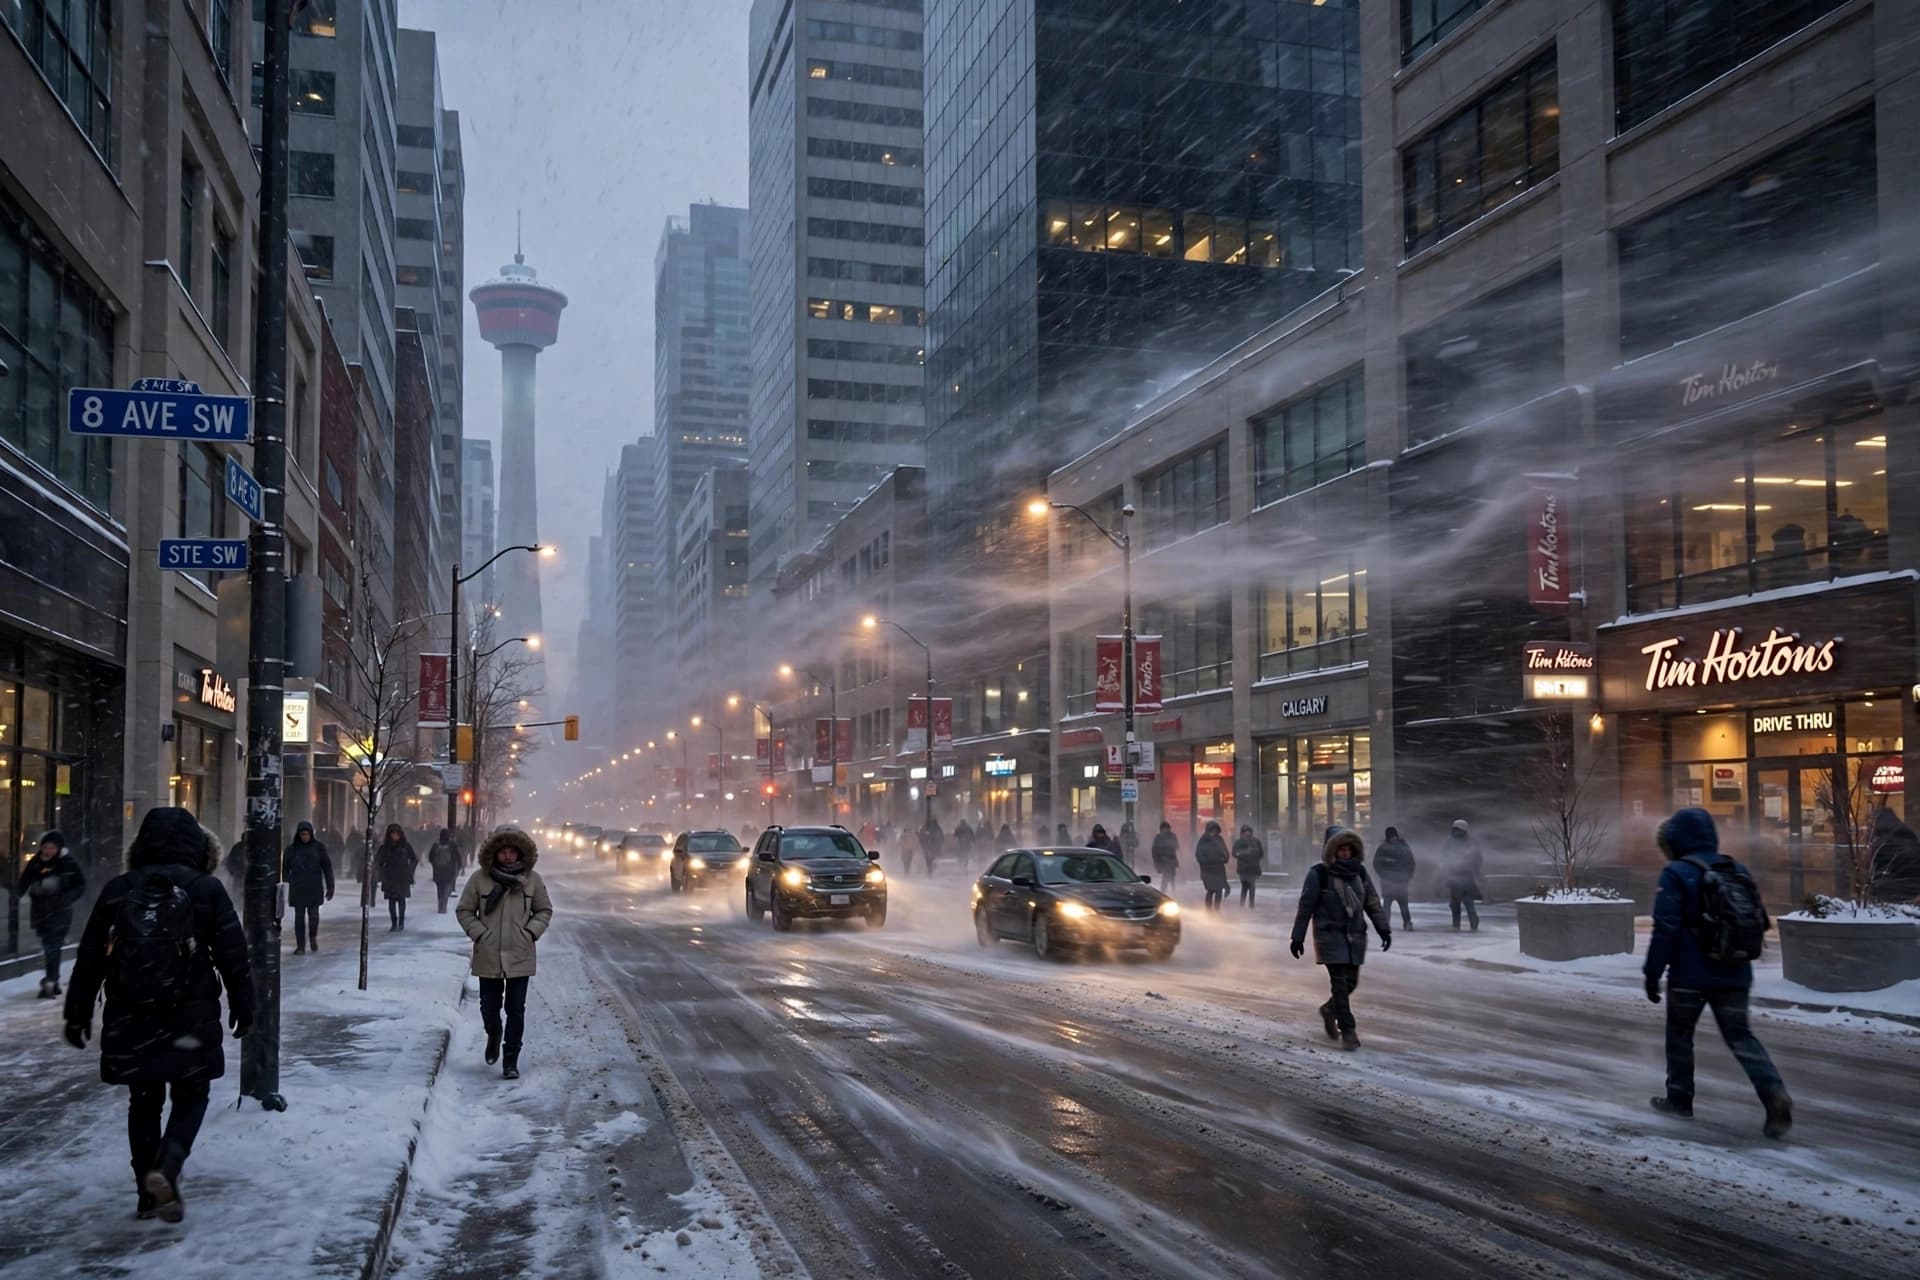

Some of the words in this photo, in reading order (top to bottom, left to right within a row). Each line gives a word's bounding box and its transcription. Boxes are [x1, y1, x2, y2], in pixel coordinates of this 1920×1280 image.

[1679, 372, 1714, 406] Tim
[82, 396, 104, 428] 8
[121, 400, 177, 431] AVE
[192, 404, 236, 434] SW
[230, 465, 236, 495] 8
[168, 545, 204, 565] STE
[211, 545, 239, 565] SW
[1538, 560, 1560, 591] Tim
[1526, 649, 1552, 669] Tim
[1641, 638, 1696, 691] Tim
[1702, 629, 1835, 685] Hortons
[1282, 696, 1325, 717] CALGARY
[1753, 715, 1793, 733] DRIVE
[1795, 711, 1833, 730] THRU
